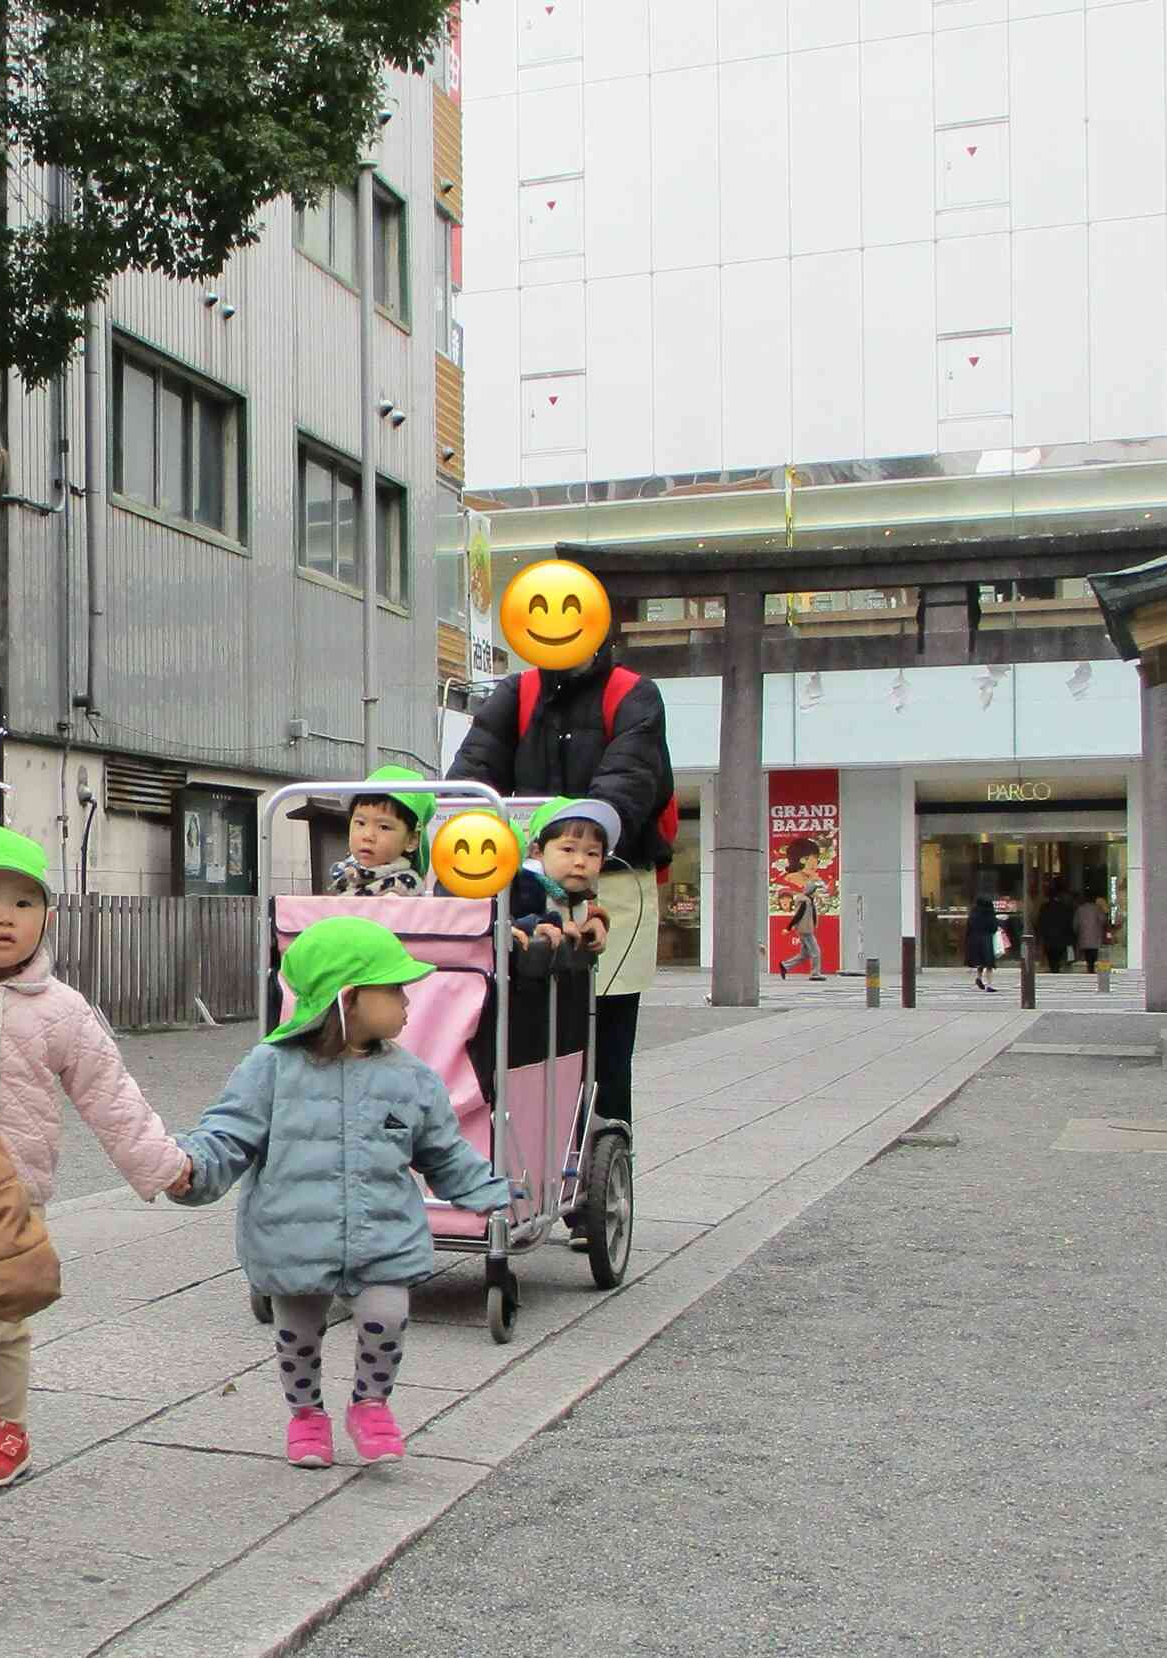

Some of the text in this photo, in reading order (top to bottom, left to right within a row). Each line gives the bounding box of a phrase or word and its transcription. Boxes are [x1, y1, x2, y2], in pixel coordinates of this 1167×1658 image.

[987, 782, 1051, 800] PARCO
[771, 804, 838, 818] GRAND
[772, 818, 837, 832] BAZAR
